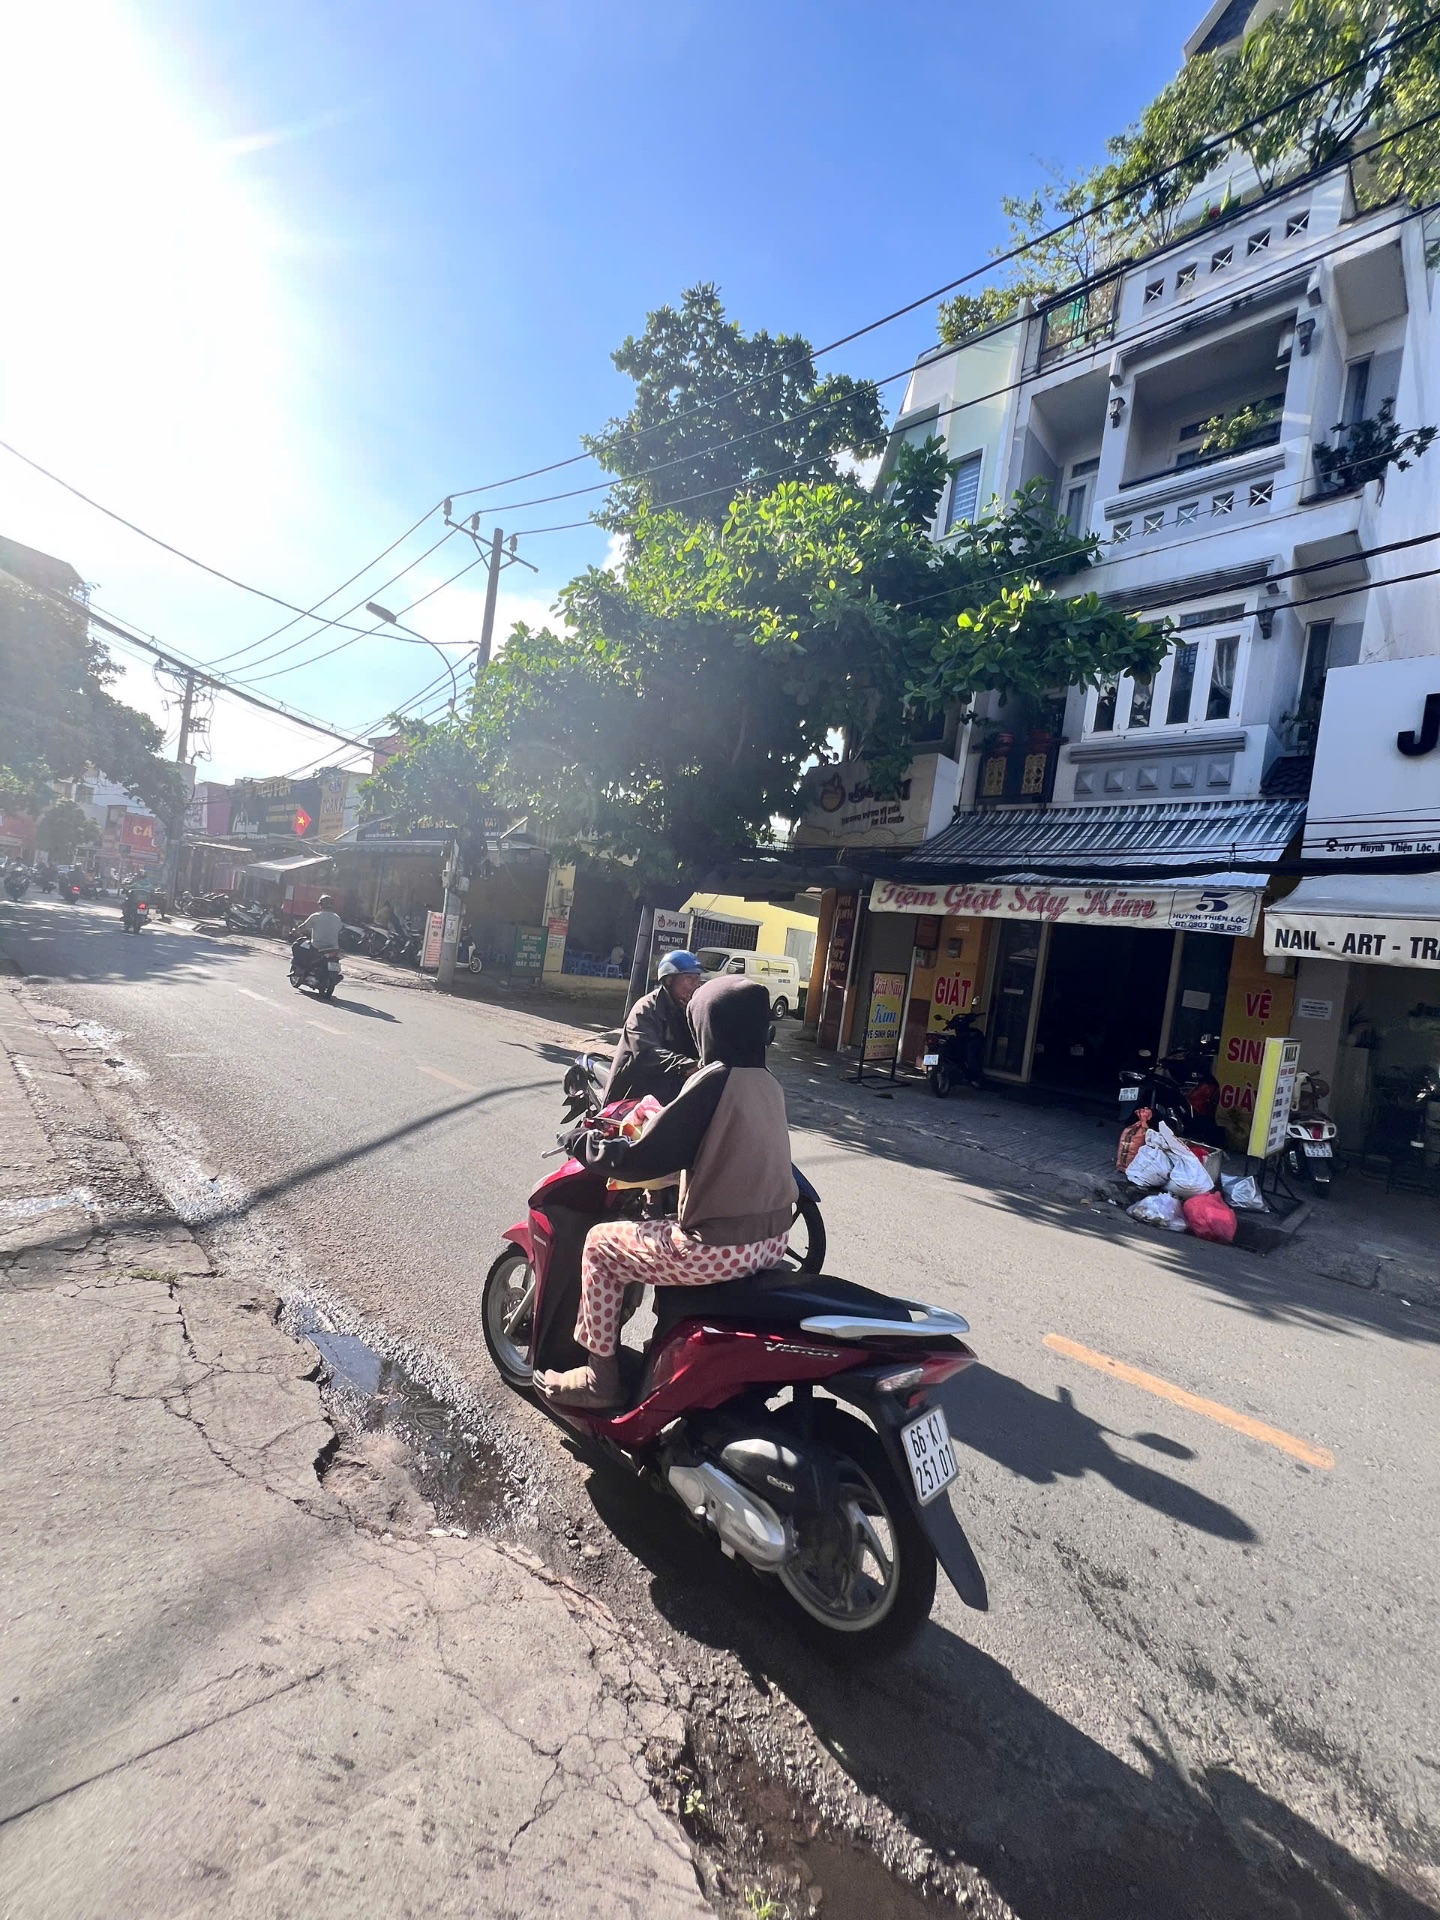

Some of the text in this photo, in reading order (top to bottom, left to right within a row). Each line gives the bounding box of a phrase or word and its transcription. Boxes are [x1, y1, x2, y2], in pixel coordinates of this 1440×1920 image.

[878, 883, 938, 909] Tiệm
[943, 884, 1002, 915] Giặt
[1077, 888, 1157, 918] Kim
[1196, 891, 1229, 912] 5
[1173, 912, 1201, 920] HUỲNH
[1230, 916, 1248, 924] LỘC
[1188, 921, 1207, 929] 0903
[1275, 928, 1321, 952] NAIL
[1341, 932, 1386, 956] ART
[1410, 936, 1440, 961] TR
[1220, 1082, 1257, 1113] GIÀ
[916, 1444, 955, 1497] 251.01
